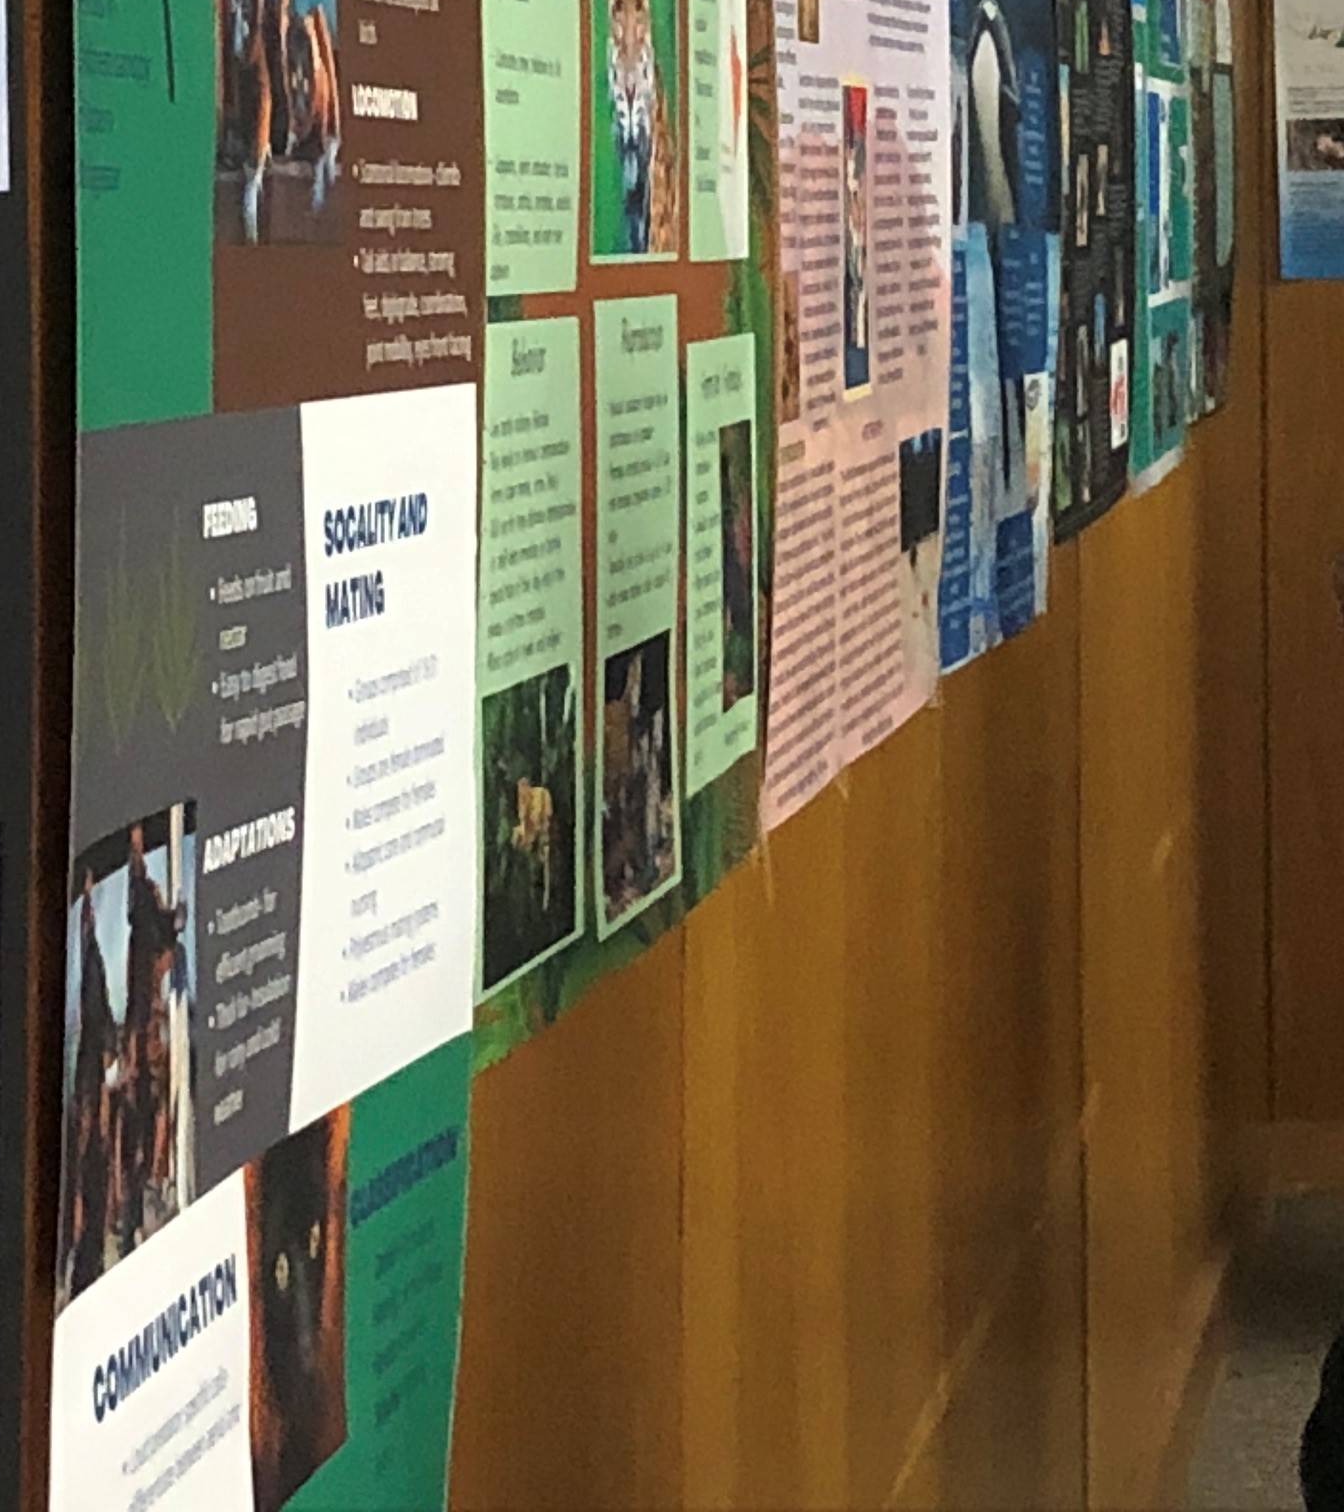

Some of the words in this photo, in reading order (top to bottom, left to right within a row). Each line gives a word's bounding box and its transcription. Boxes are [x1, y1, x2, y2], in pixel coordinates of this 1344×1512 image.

[397, 492, 428, 539] AND
[325, 570, 386, 628] MATING
[93, 1253, 238, 1424] COMMUNICATION
